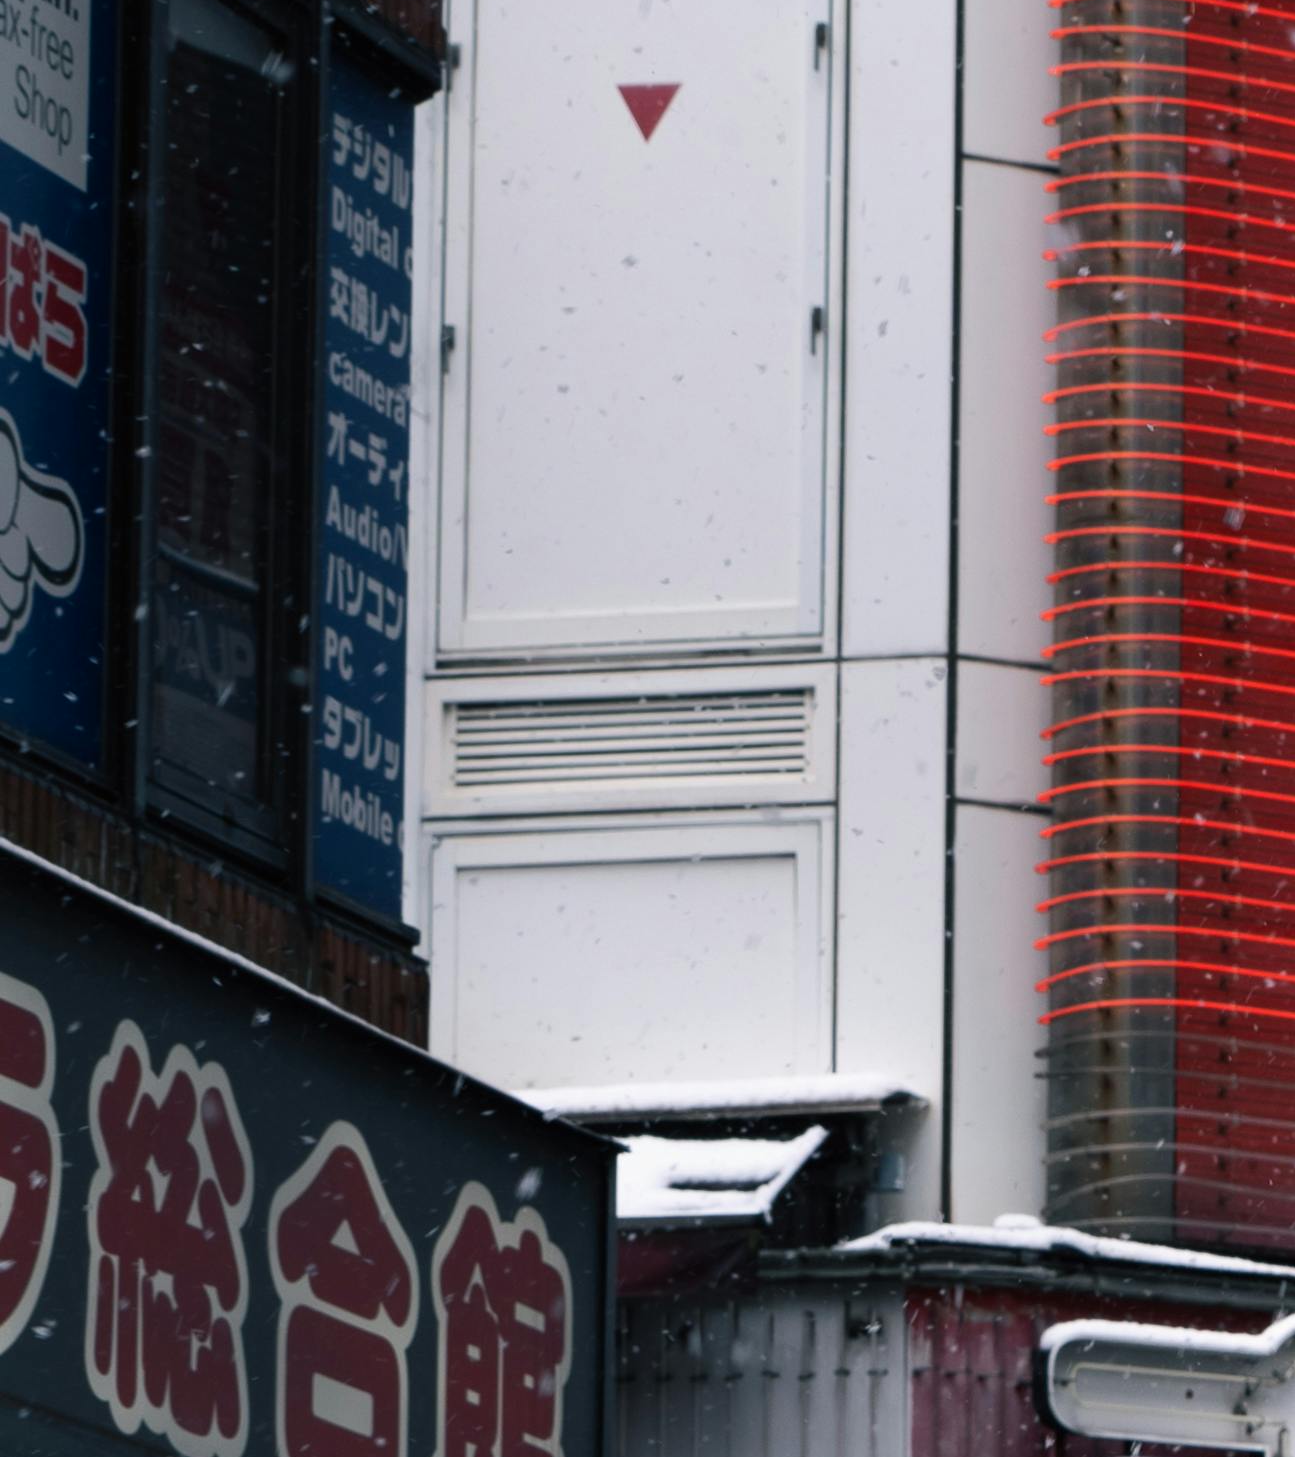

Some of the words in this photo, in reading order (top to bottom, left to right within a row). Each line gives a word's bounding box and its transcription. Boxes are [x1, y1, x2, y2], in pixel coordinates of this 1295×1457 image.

[14, 62, 74, 156] Shop
[332, 185, 399, 270] Digital
[0, 212, 88, 389] ぱら
[325, 553, 405, 640] パソコン
[324, 626, 354, 681] PC
[321, 768, 394, 845] Mobile
